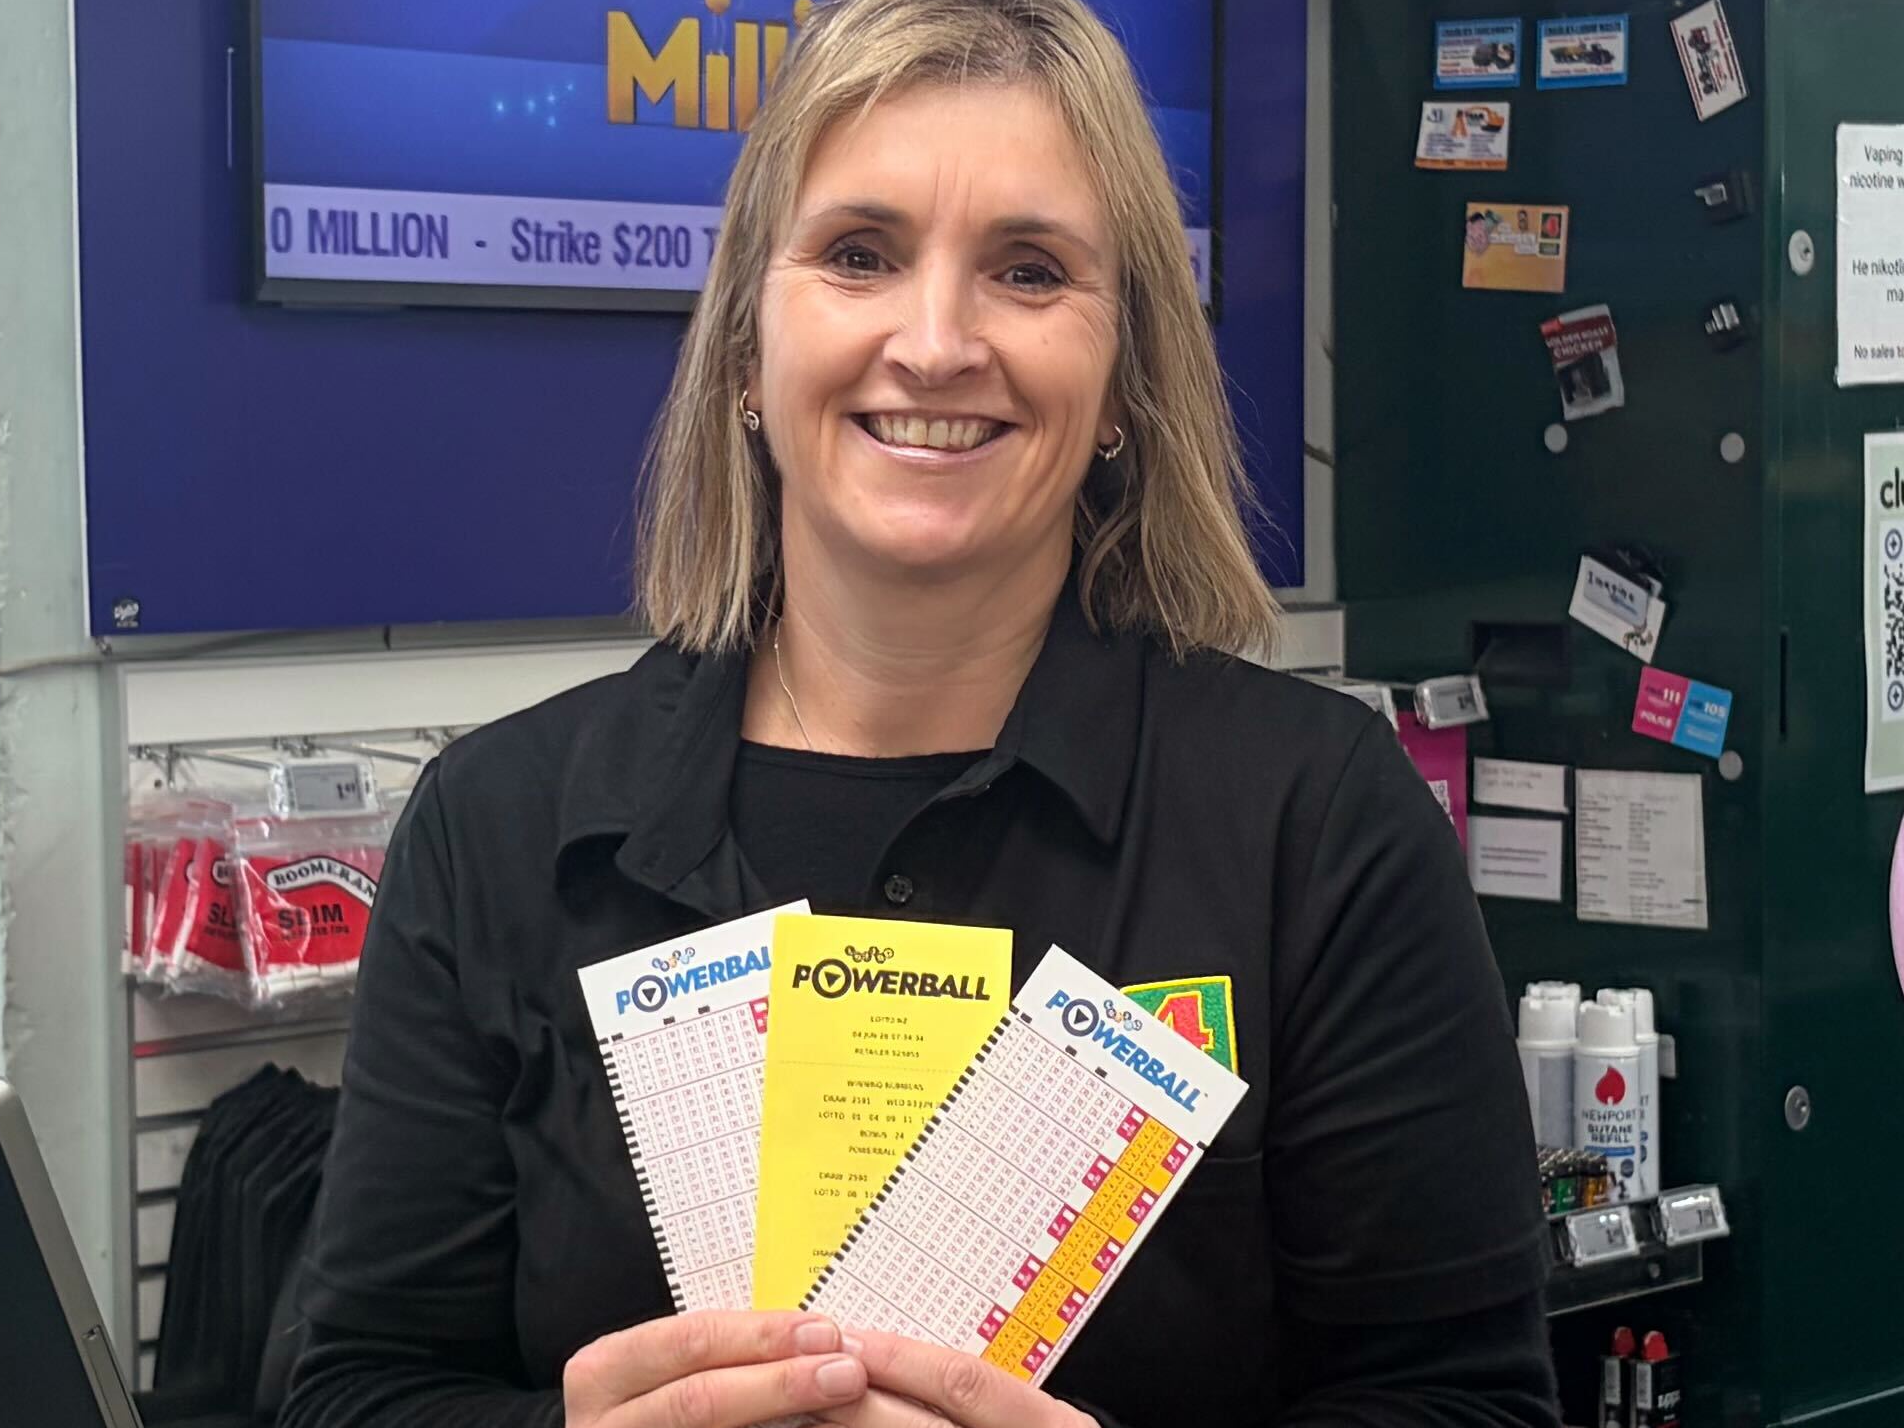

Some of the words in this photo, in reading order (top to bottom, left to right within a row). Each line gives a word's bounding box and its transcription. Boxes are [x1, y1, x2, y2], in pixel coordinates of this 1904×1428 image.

[1864, 145, 1903, 166] Vaping
[1850, 172, 1894, 189] nicotine
[307, 206, 449, 260] MILLION
[510, 215, 602, 266] Strike
[612, 221, 691, 277] $200
[1854, 344, 1868, 358] No
[1871, 344, 1894, 359] sales
[273, 861, 376, 897] BOOMERAN
[278, 903, 343, 929] SLIM
[615, 944, 774, 1016] POWERBAL
[792, 959, 990, 1001] POWERBALL
[1044, 988, 1200, 1114] POWERBALL
